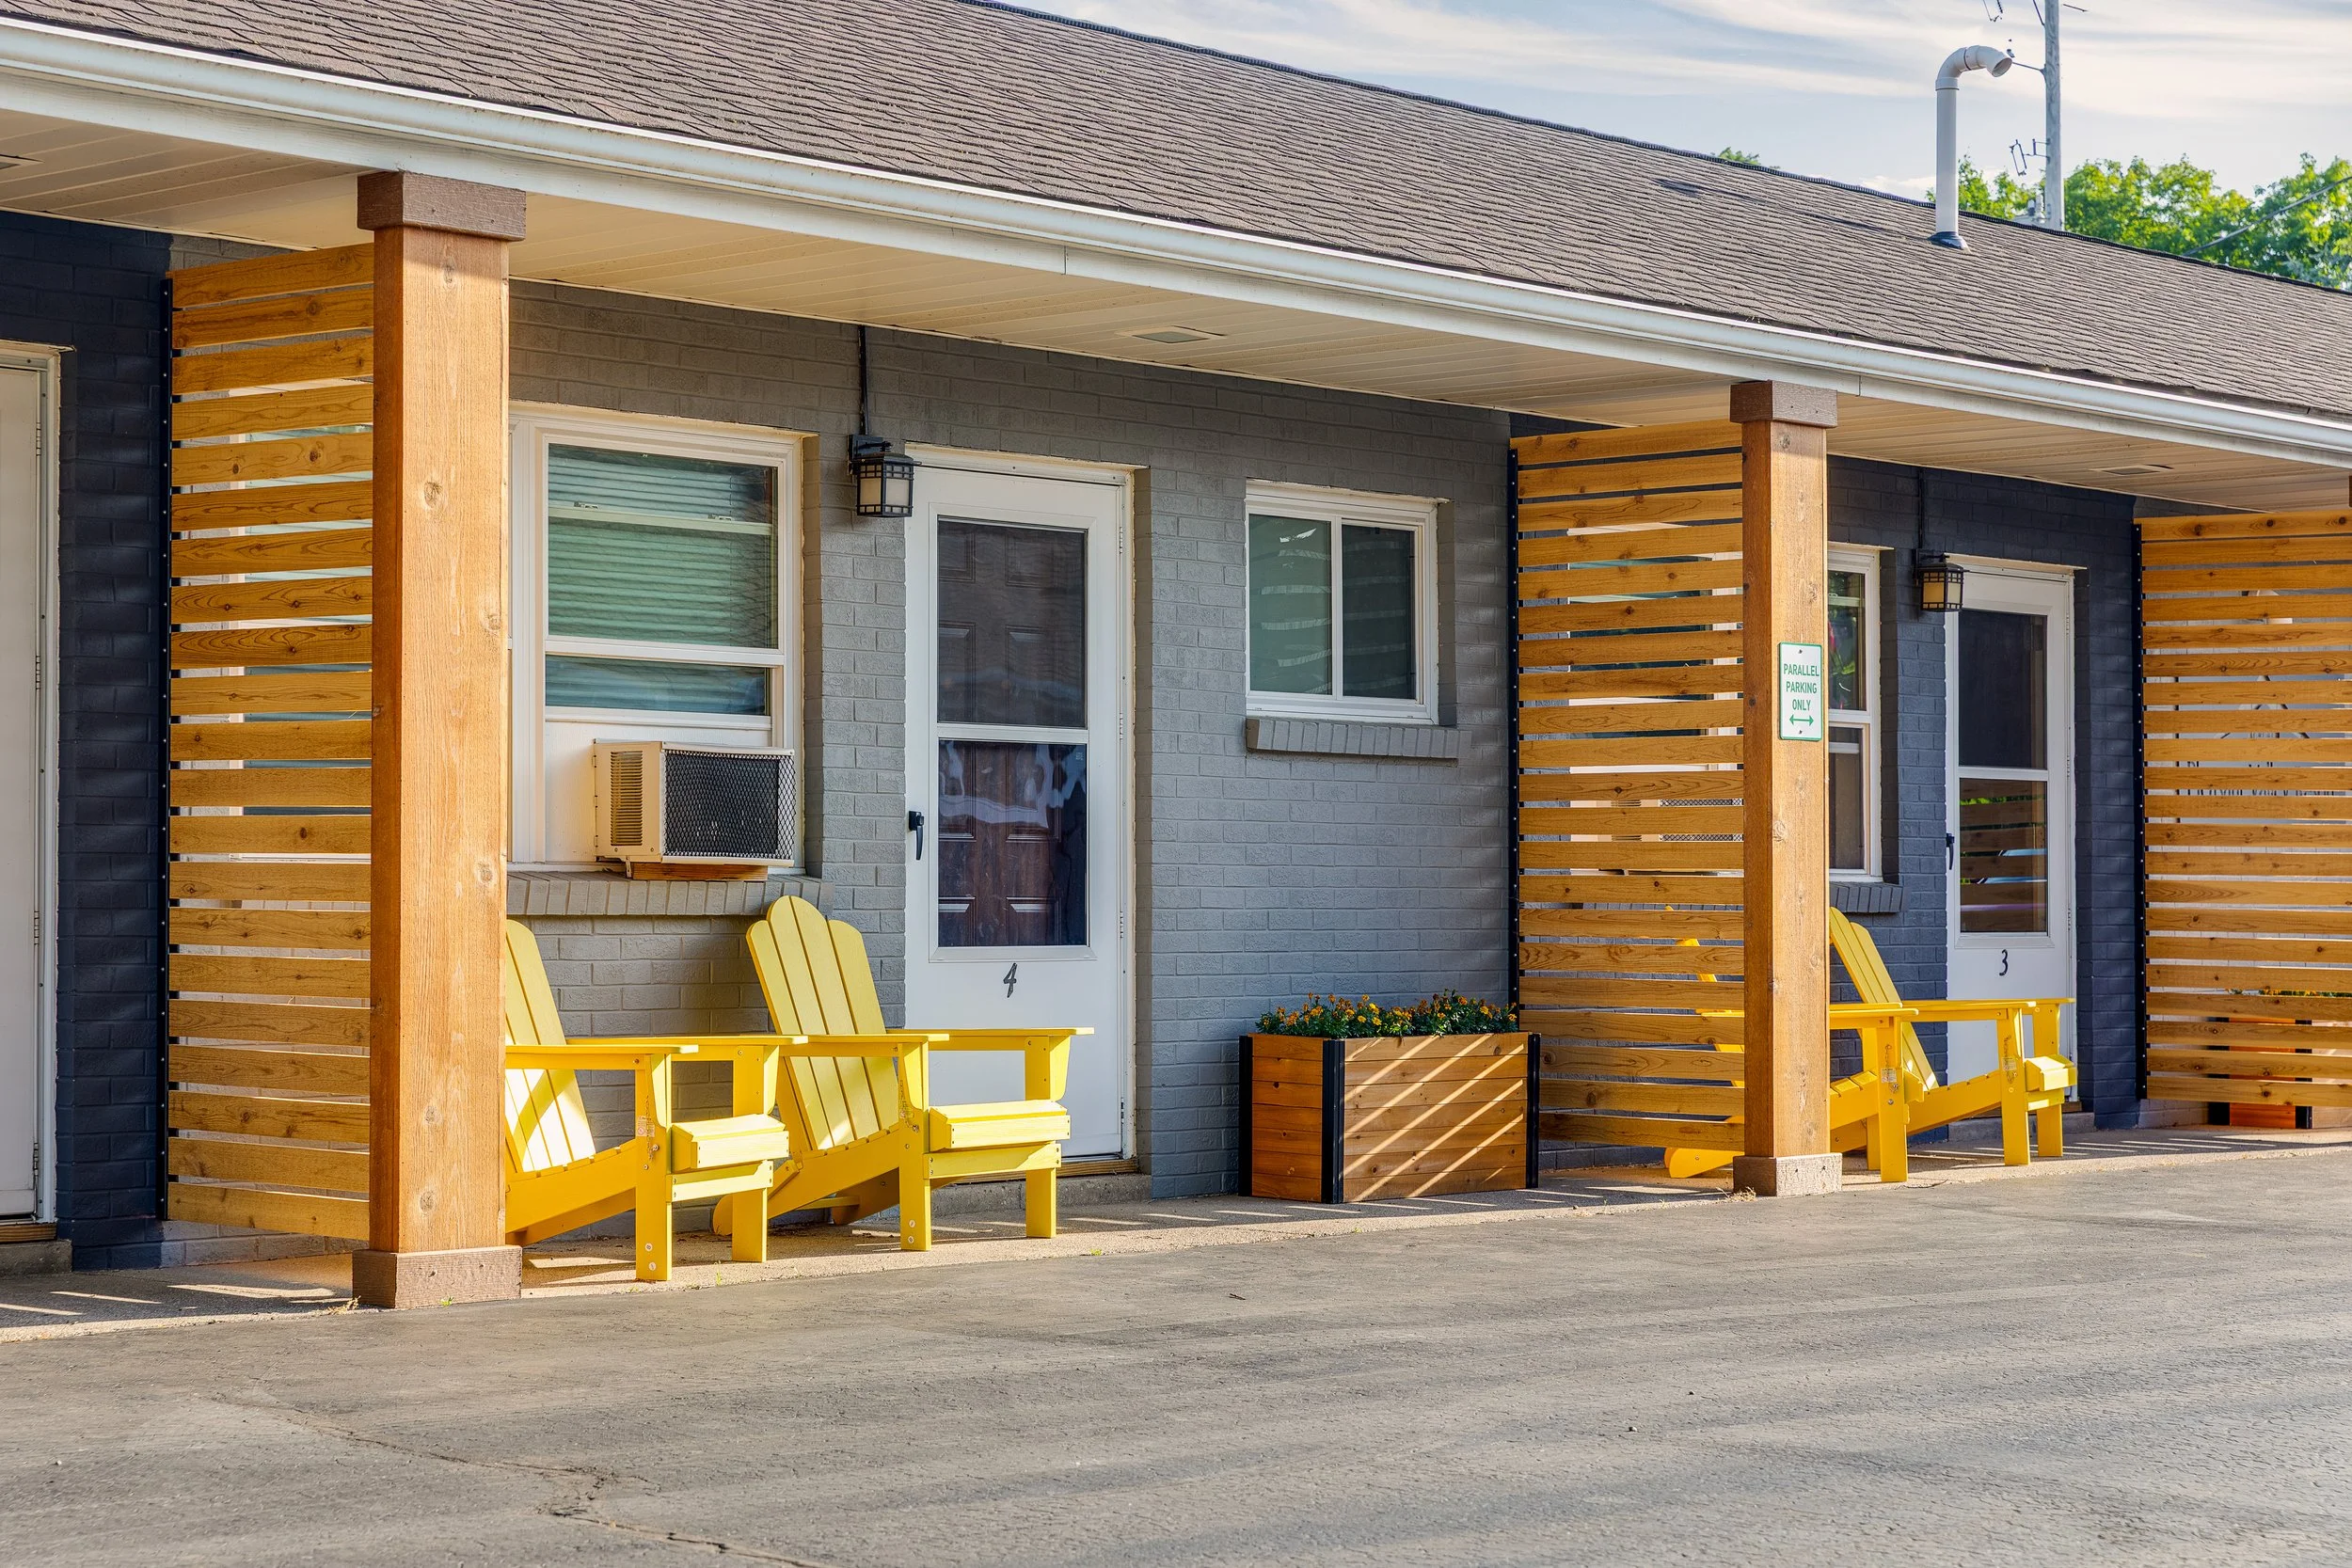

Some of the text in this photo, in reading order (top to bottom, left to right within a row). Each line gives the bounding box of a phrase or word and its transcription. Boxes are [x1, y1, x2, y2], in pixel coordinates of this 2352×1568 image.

[1784, 663, 1820, 676] PARALLEL
[1786, 681, 1818, 693] PARKING
[1792, 699, 1811, 711] ONLY
[1999, 949, 2009, 976] 3
[1003, 962, 1018, 998] 4
